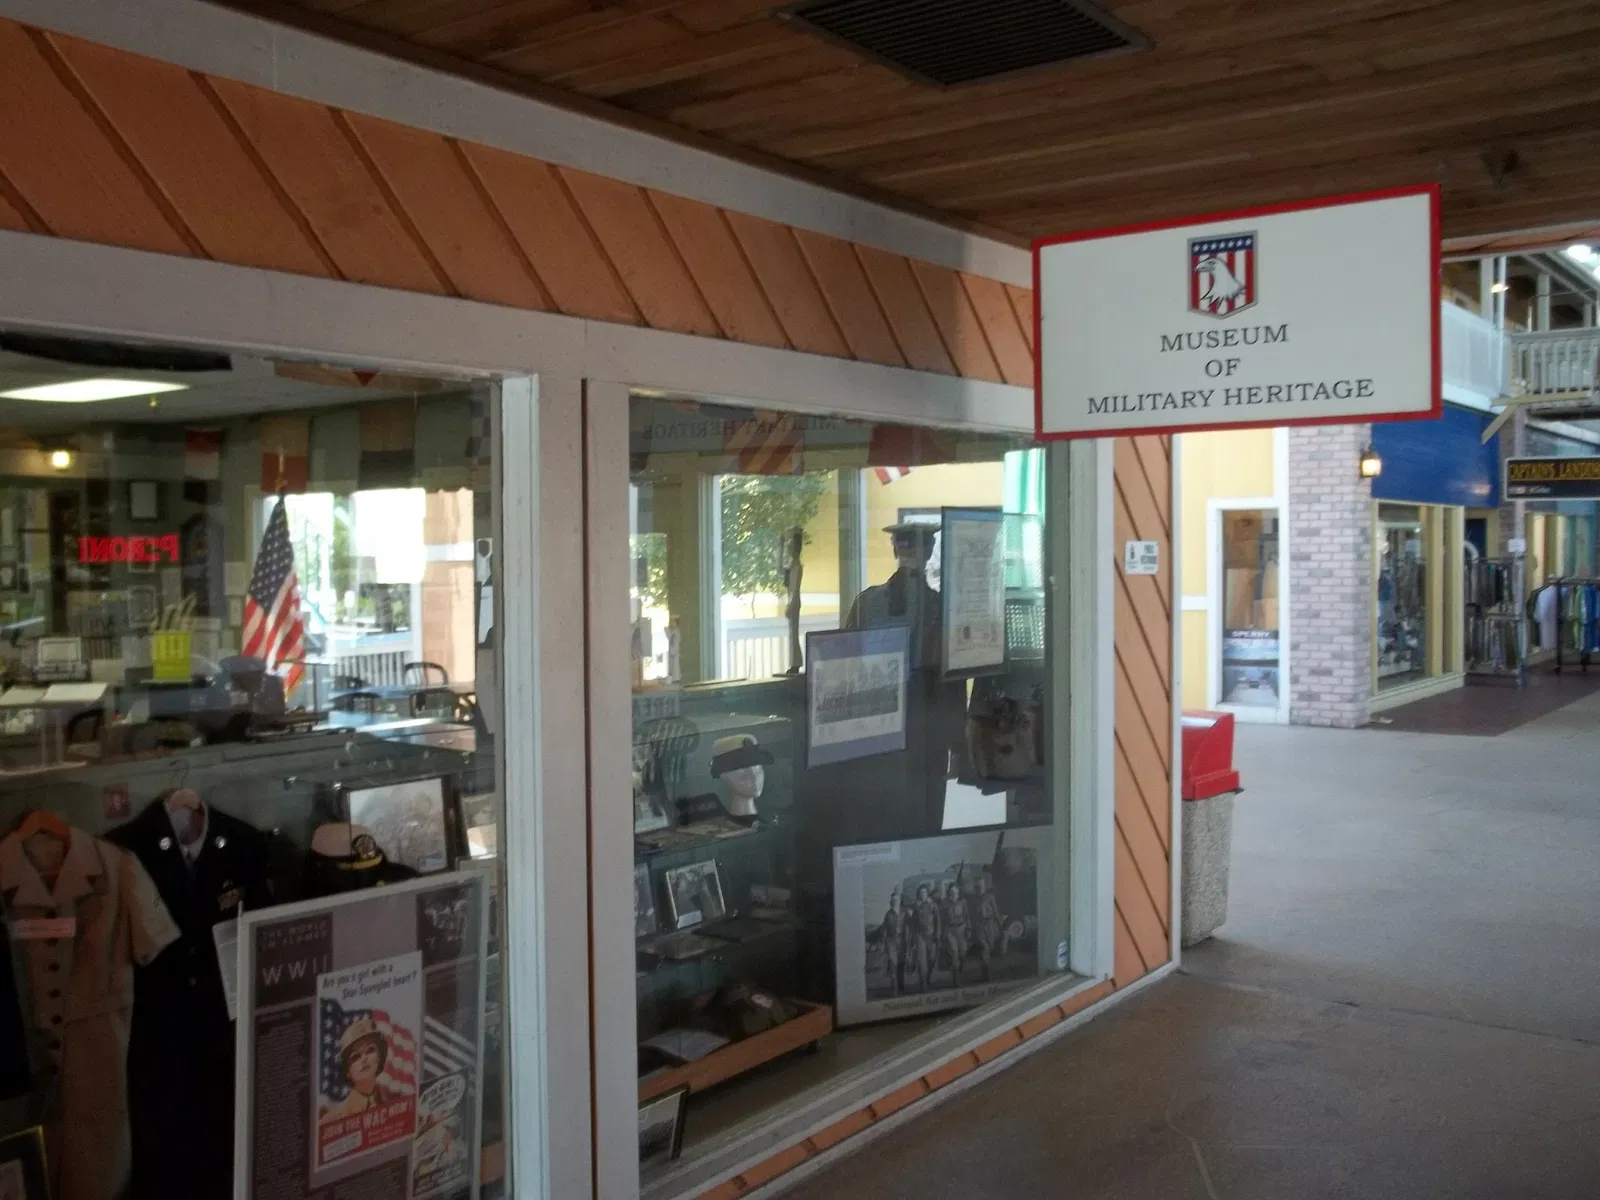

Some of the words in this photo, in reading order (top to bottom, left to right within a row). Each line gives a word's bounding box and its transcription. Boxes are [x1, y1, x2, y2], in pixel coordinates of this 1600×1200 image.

[1160, 324, 1289, 353] MUSEUM
[1205, 358, 1241, 378] OF
[1087, 389, 1215, 416] MILITARY
[1224, 378, 1374, 407] HERITAGE
[362, 1108, 388, 1128] WAC
